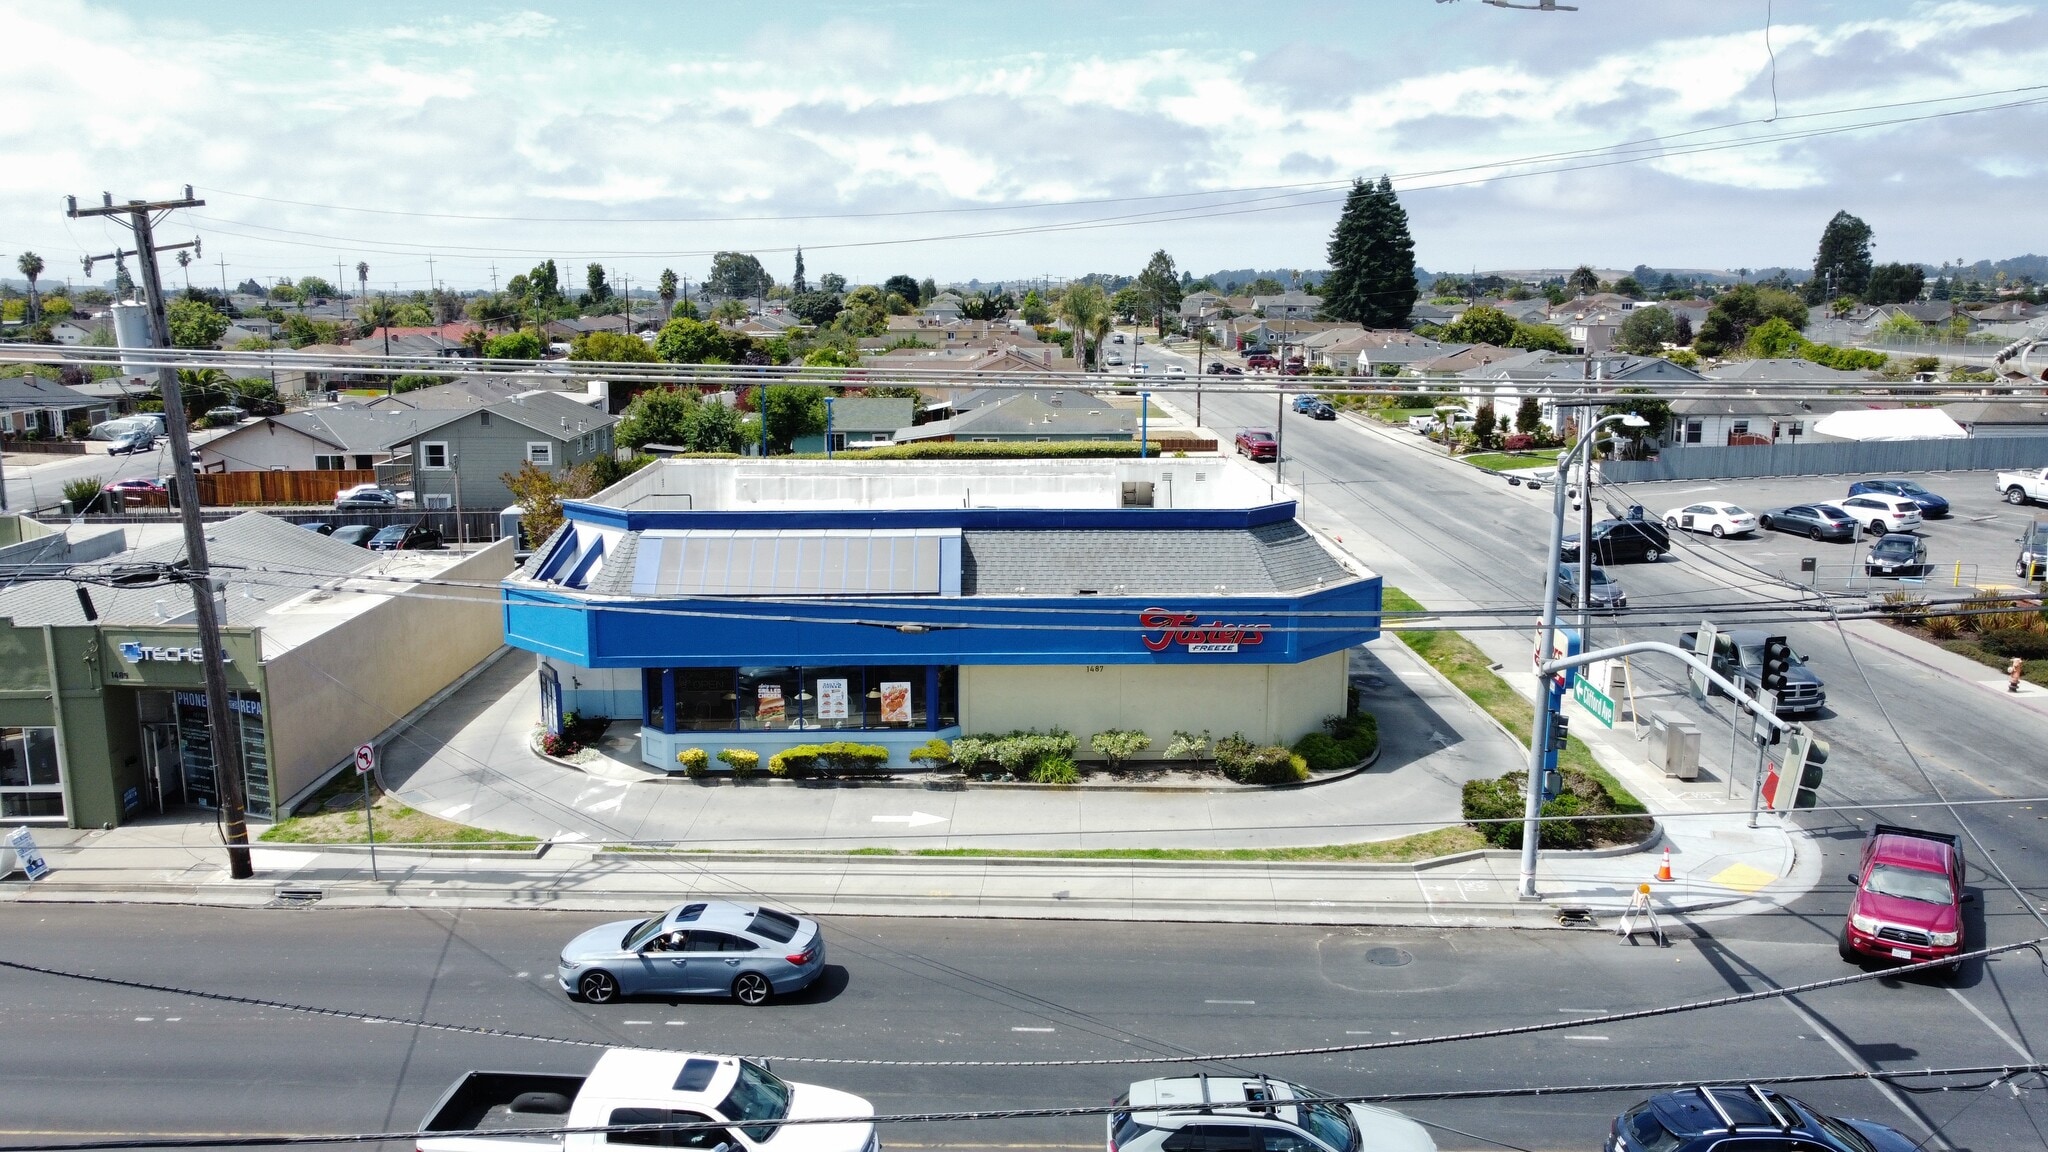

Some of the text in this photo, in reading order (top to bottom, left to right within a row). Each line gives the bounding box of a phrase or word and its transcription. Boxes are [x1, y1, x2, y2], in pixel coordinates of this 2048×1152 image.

[1139, 607, 1271, 651] Fosters
[141, 646, 233, 662] TECHS
[177, 691, 207, 707] PHONE
[240, 700, 263, 715] REPA
[1583, 685, 1612, 724] Clifford Ave
